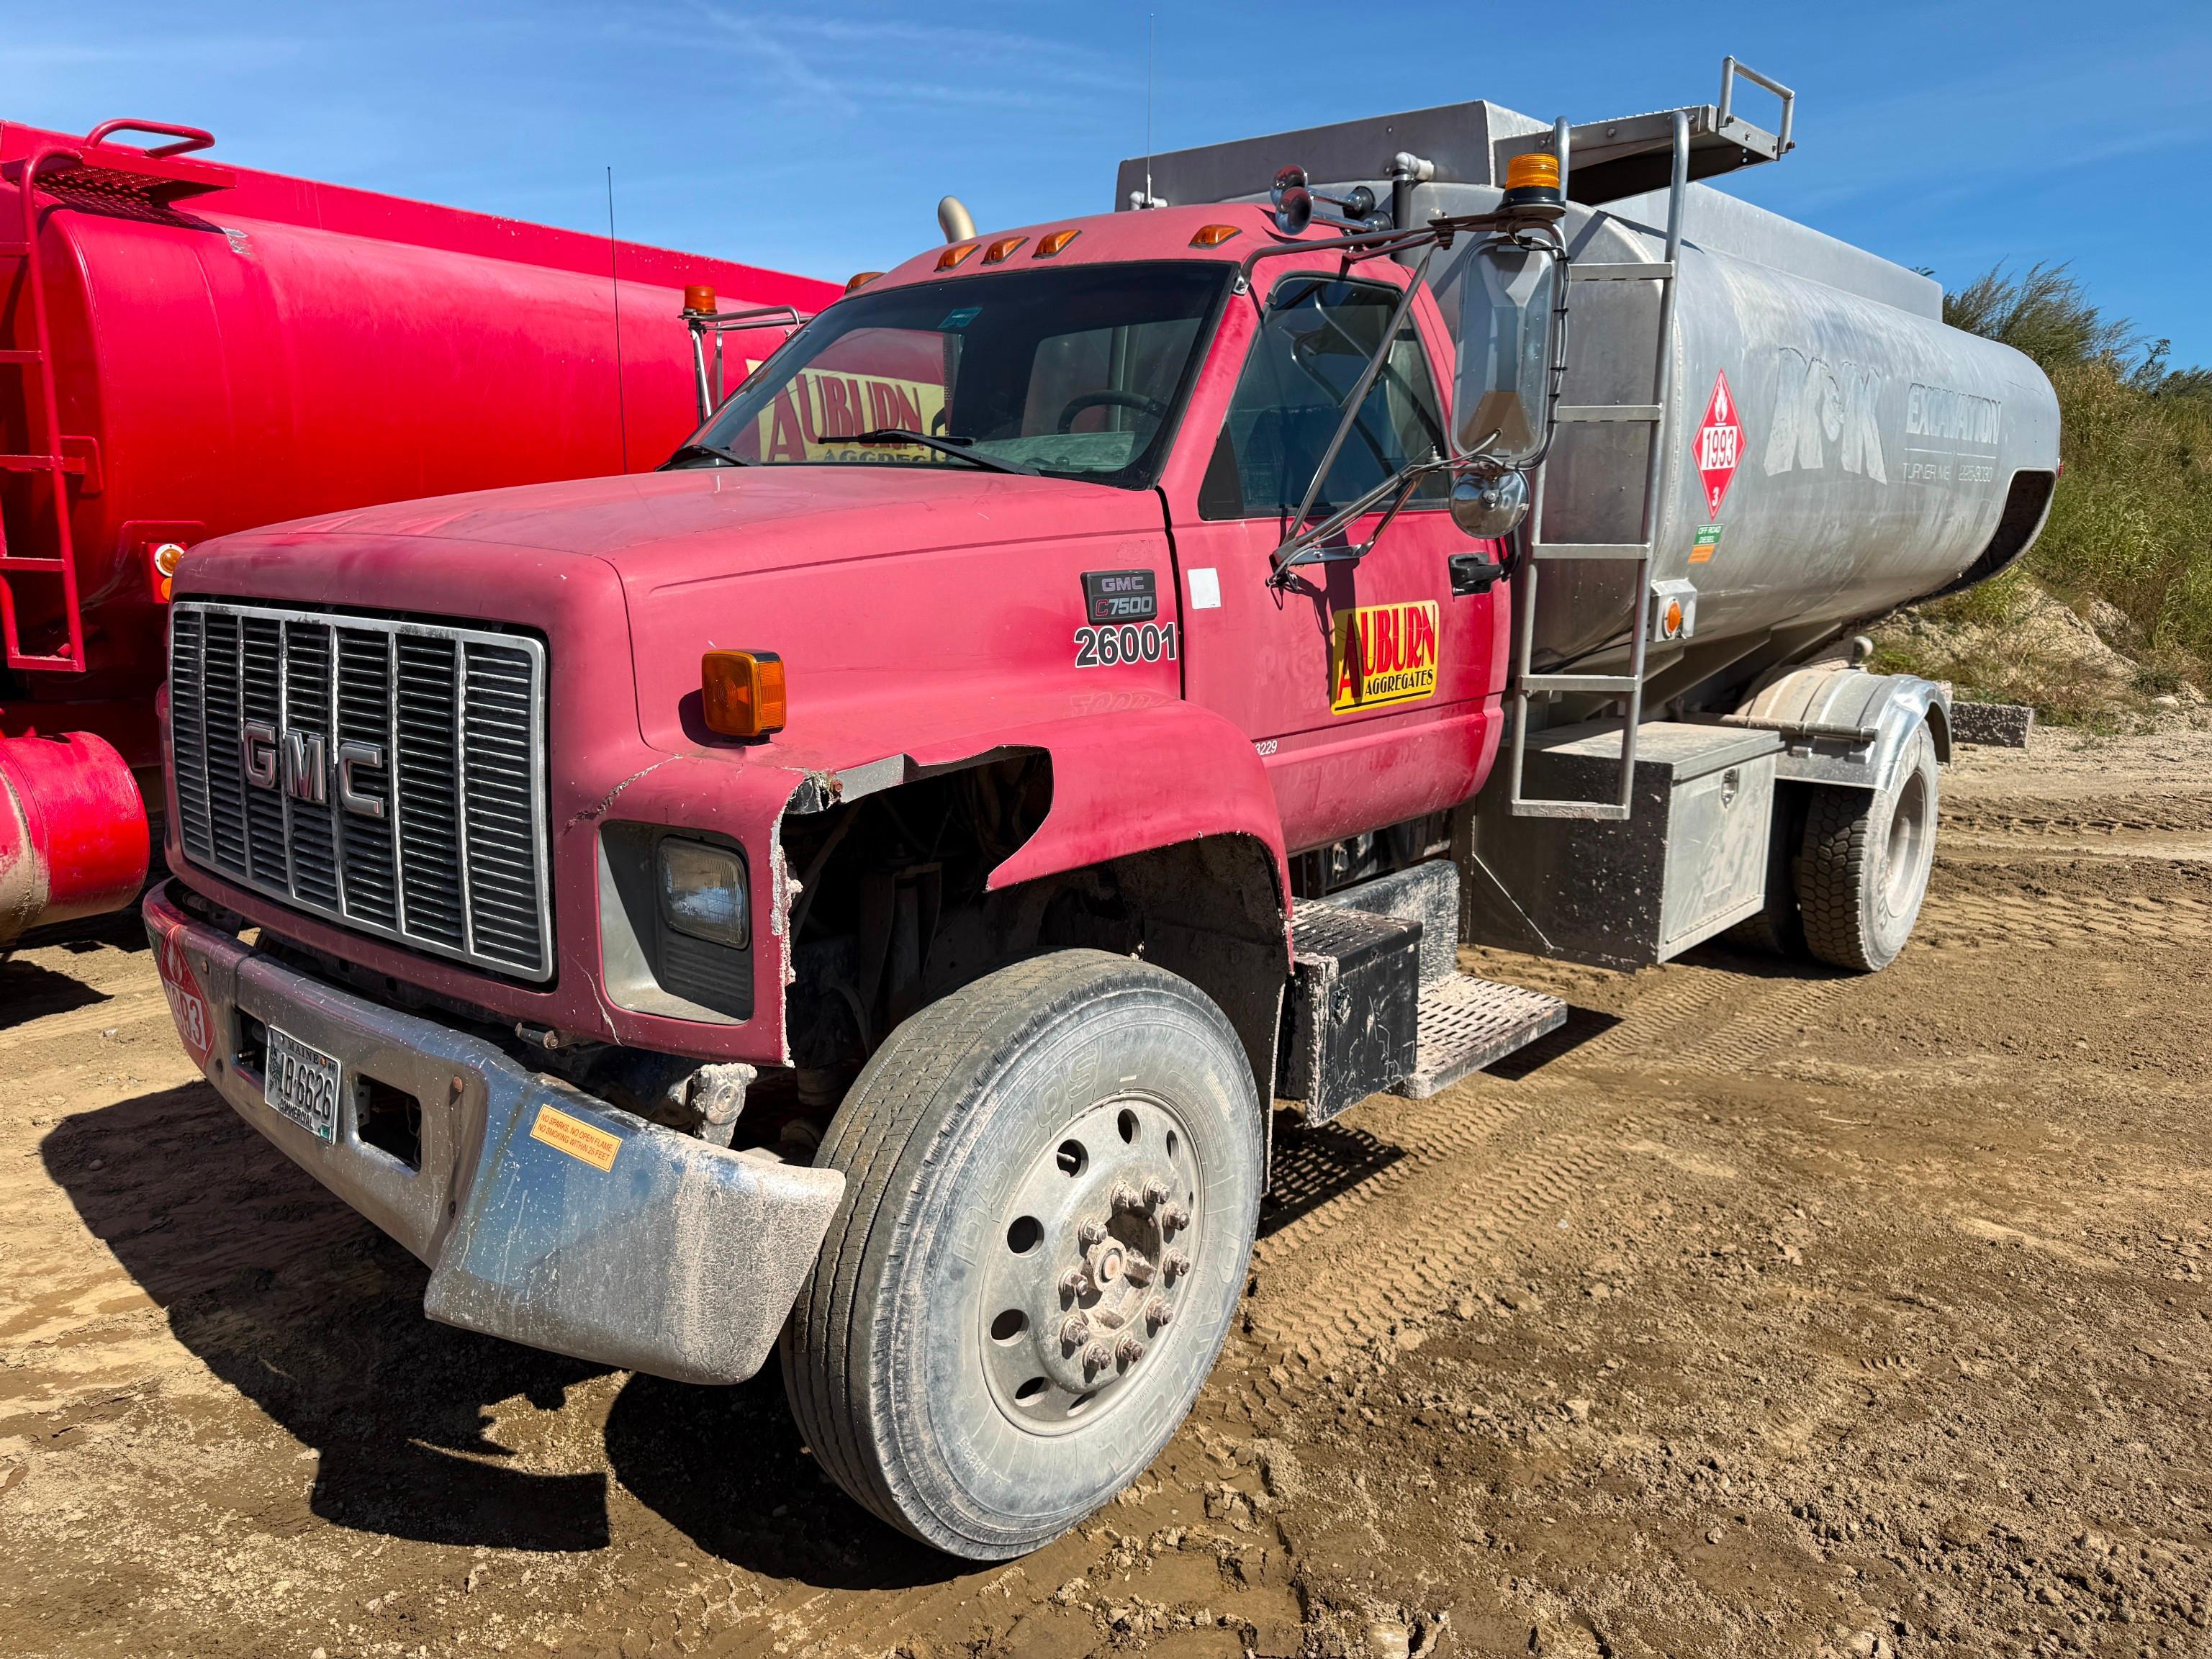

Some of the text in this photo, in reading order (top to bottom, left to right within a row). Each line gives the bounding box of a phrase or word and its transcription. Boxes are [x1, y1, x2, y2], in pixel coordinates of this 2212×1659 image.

[1705, 430, 1734, 469] 1993
[1712, 487, 1720, 507] 3
[1101, 577, 1145, 592] GMC
[1096, 596, 1152, 617] C7500
[1074, 622, 1177, 668] 26001
[1336, 605, 1435, 701] AUBURN
[1365, 669, 1433, 697] AGGREGATES
[243, 722, 384, 818] GMC
[287, 1040, 319, 1065] MAINE
[280, 1098, 313, 1129] COMMERCIAL
[541, 1113, 549, 1123] NO
[571, 1127, 579, 1136] NO
[579, 1131, 594, 1142] OPEN
[538, 1124, 610, 1162] NO SMOKING WITHIN 25 FEET
